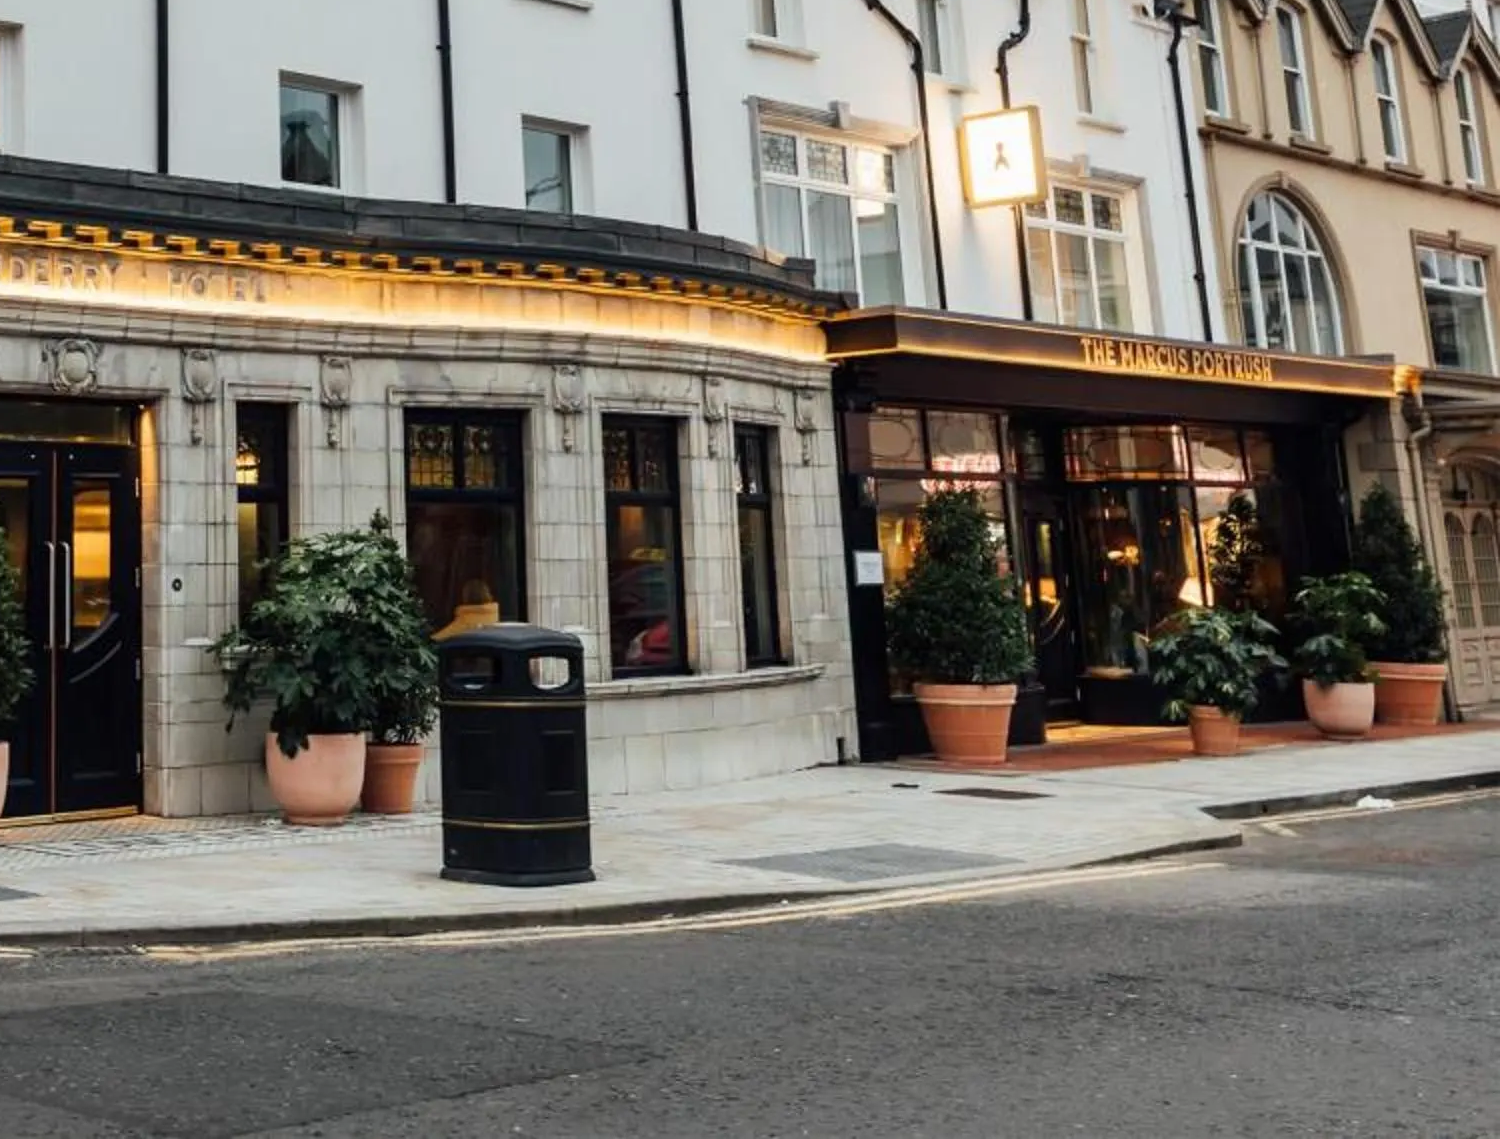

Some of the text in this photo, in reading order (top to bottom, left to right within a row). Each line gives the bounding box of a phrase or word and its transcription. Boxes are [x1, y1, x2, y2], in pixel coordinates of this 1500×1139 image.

[1080, 337, 1274, 383] THE MARCUS PORTRUSH
